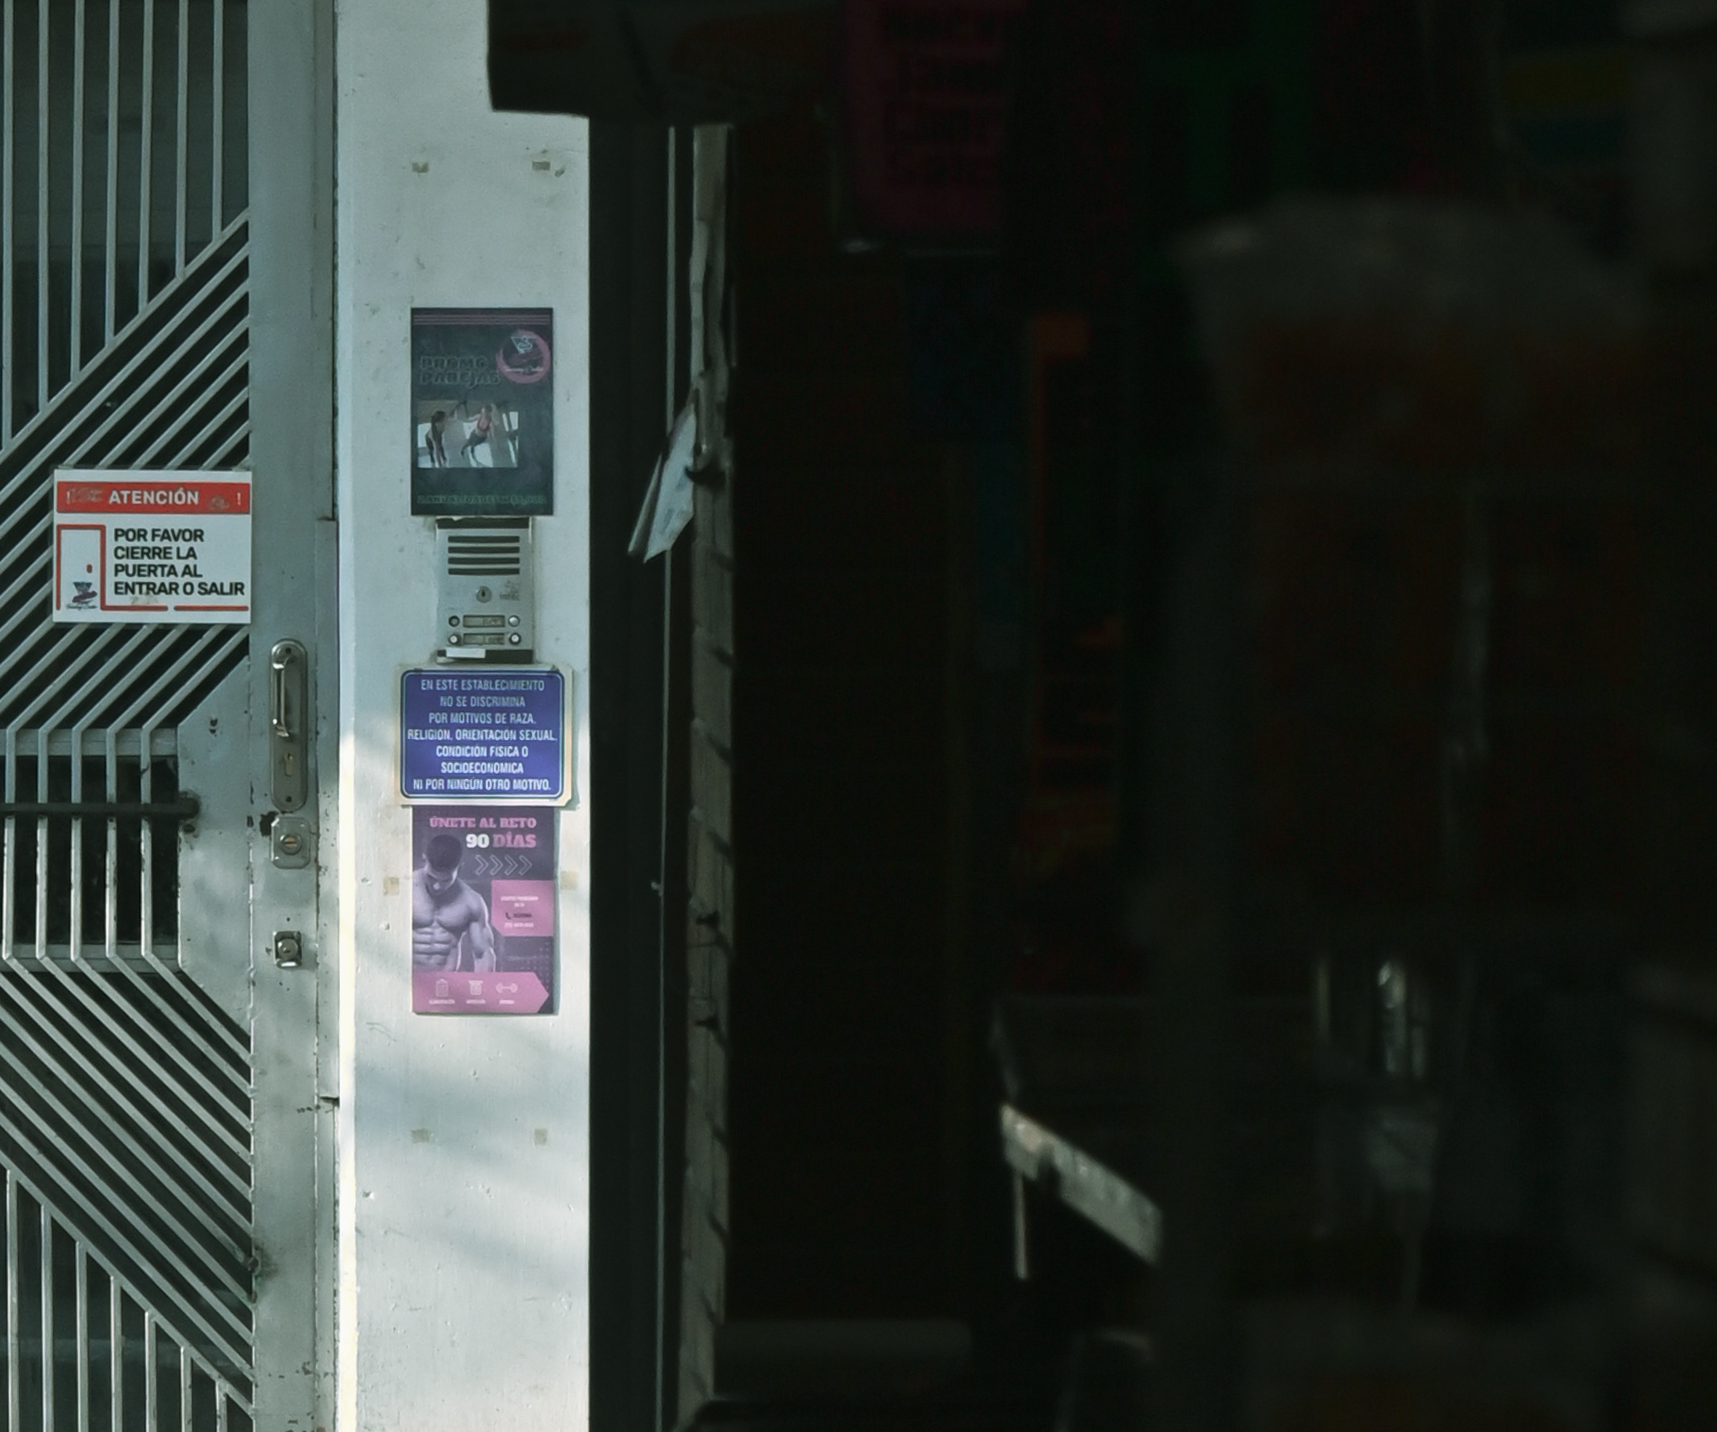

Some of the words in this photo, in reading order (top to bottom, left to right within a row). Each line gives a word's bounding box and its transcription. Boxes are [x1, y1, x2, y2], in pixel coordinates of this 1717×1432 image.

[108, 487, 199, 505] ATENCIÓN
[114, 528, 148, 542] POR
[151, 528, 204, 542] FAVOR
[113, 546, 173, 560] CIERRE
[176, 546, 197, 560] LA
[114, 564, 178, 578] PUERTA
[181, 564, 203, 578] AL
[114, 582, 179, 596] ENTRAR
[183, 582, 194, 596] O
[198, 582, 245, 596] SALIR
[421, 679, 434, 691] EN
[436, 679, 458, 691] ESTE
[461, 679, 545, 691] ESTABLECIMIENTO
[440, 696, 453, 707] NO
[456, 696, 468, 707] SE
[470, 696, 526, 708] DISCRIMINA
[429, 712, 449, 724] POR
[450, 712, 492, 724] MOTIVOS
[495, 712, 508, 724] DE
[521, 745, 529, 757] O
[413, 779, 423, 790] NI
[425, 779, 445, 790] POR
[447, 777, 483, 790] NINGÚN
[485, 779, 511, 790] OTRO
[429, 816, 476, 828] ÚNETE
[479, 817, 497, 828] AL
[499, 817, 537, 828] RETO
[465, 833, 490, 849] 90
[492, 831, 537, 848] DÍAS
